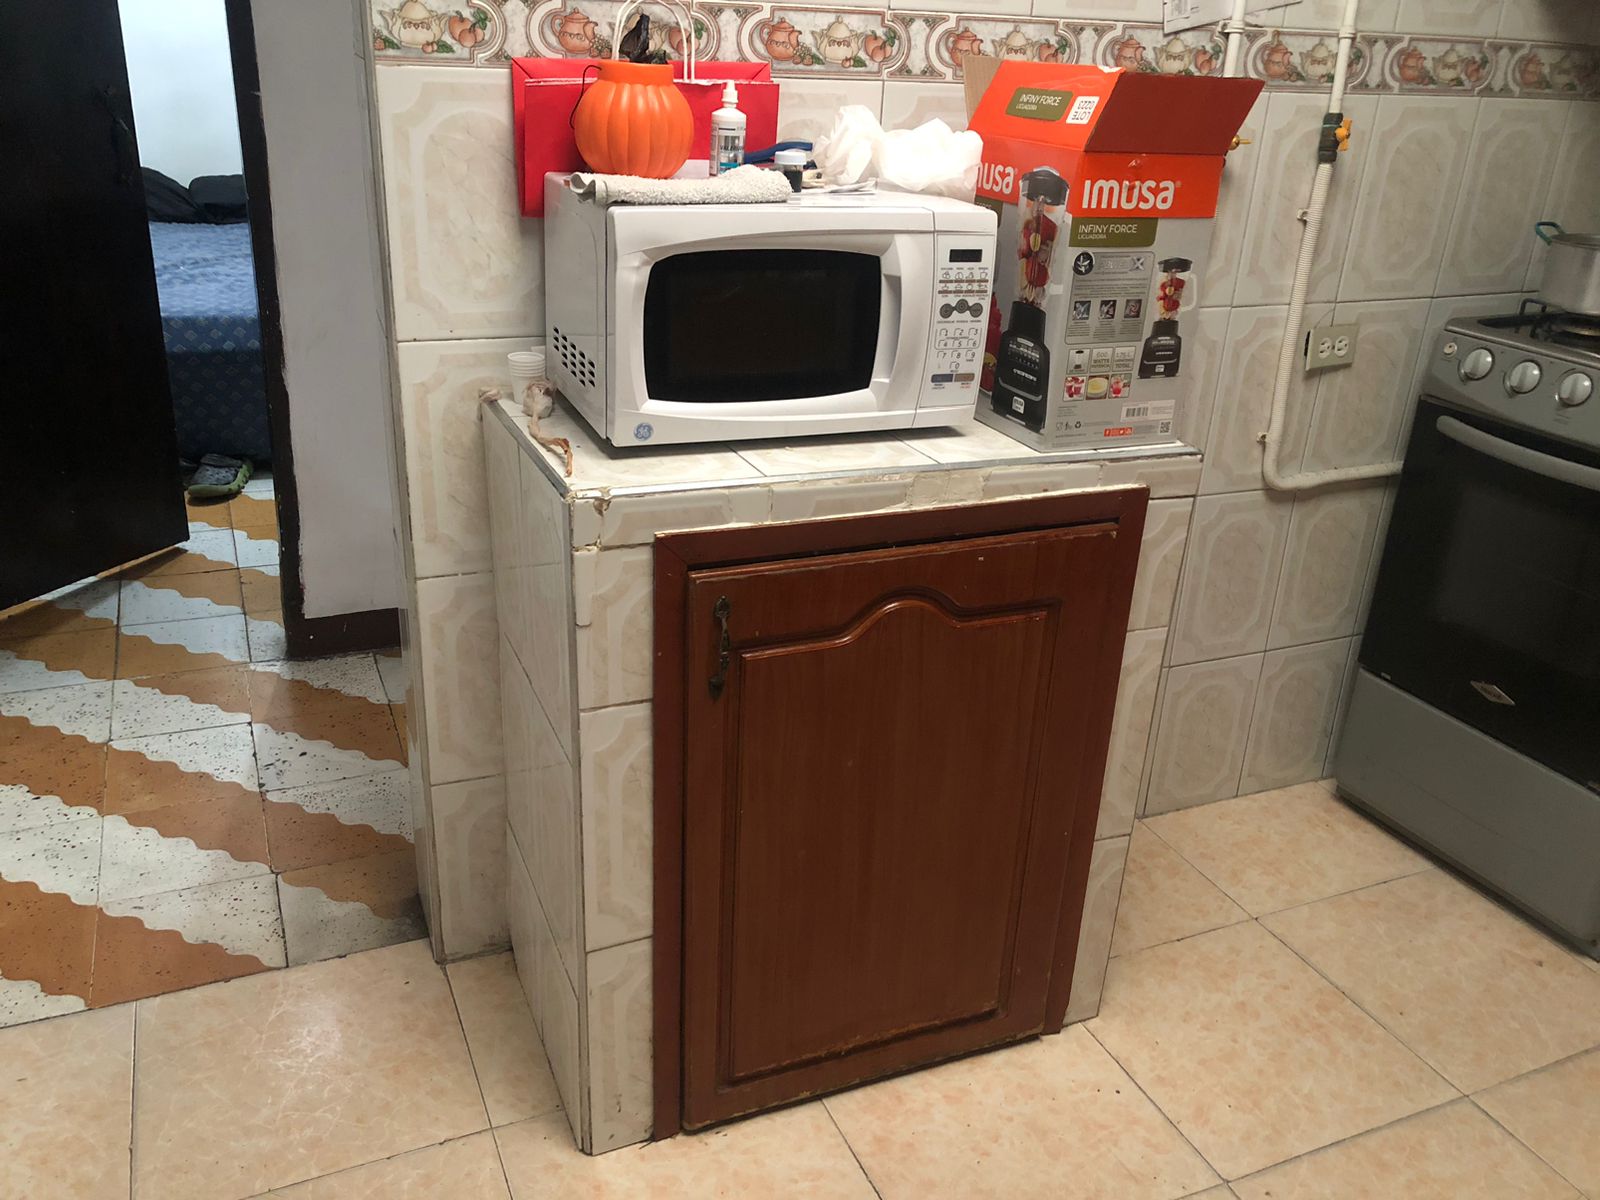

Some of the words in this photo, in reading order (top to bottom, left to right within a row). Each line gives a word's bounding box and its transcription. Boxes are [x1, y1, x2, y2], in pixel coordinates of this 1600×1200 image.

[1020, 94, 1040, 104] INFINY
[1039, 95, 1062, 106] FORCE
[978, 162, 1015, 195] usa
[1078, 224, 1109, 234] INFINY
[1109, 224, 1138, 234] FORCE
